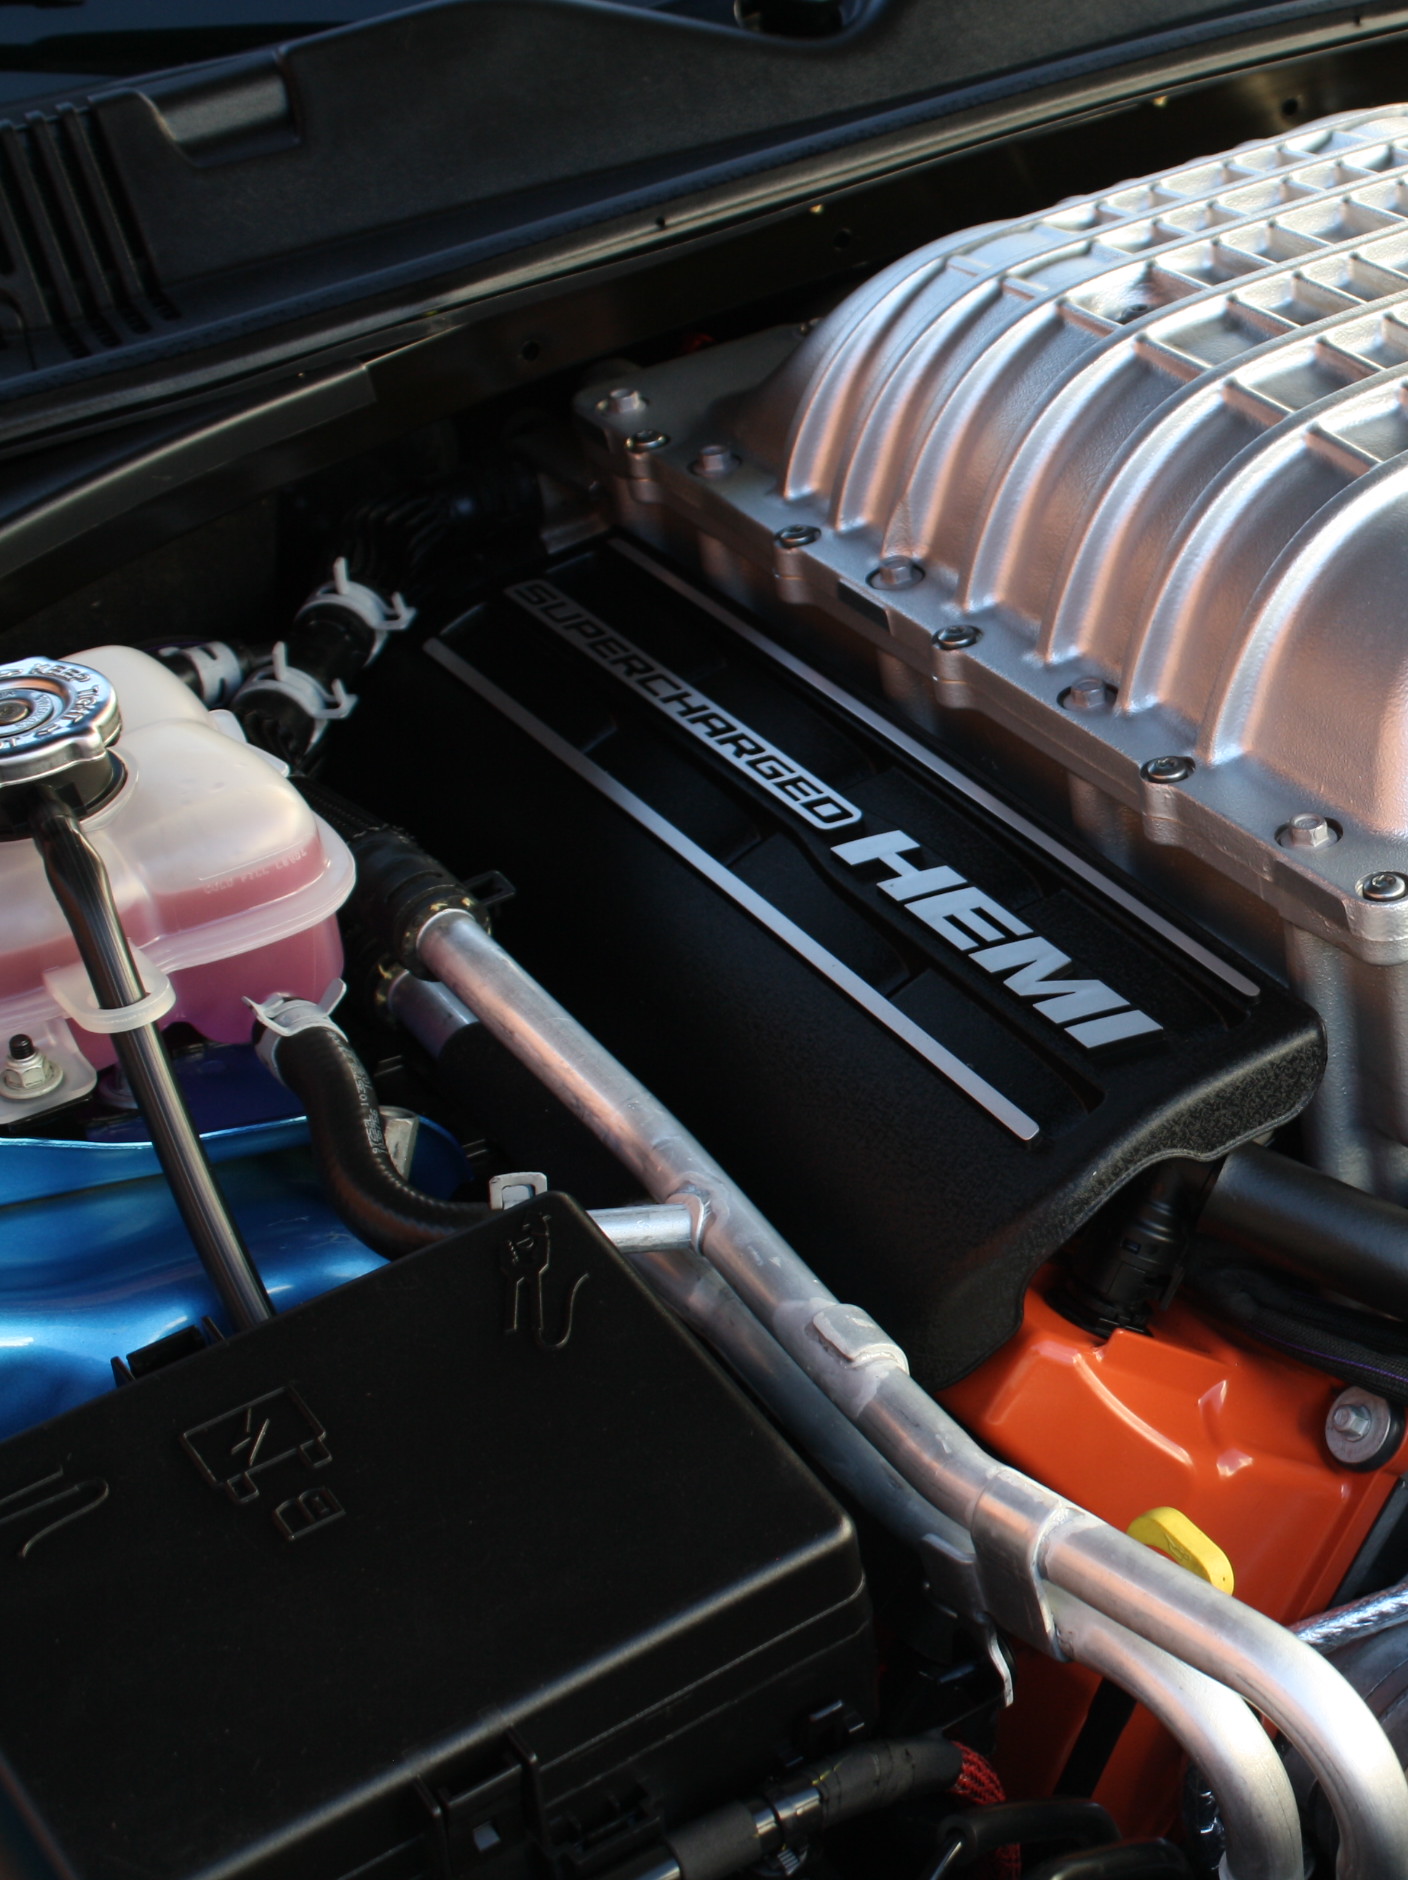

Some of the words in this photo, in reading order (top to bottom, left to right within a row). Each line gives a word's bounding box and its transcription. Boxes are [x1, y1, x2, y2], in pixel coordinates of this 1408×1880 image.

[28, 663, 91, 682] KEEP
[516, 583, 856, 828] SUPERCHARGED
[830, 830, 1164, 1049] HEMI
